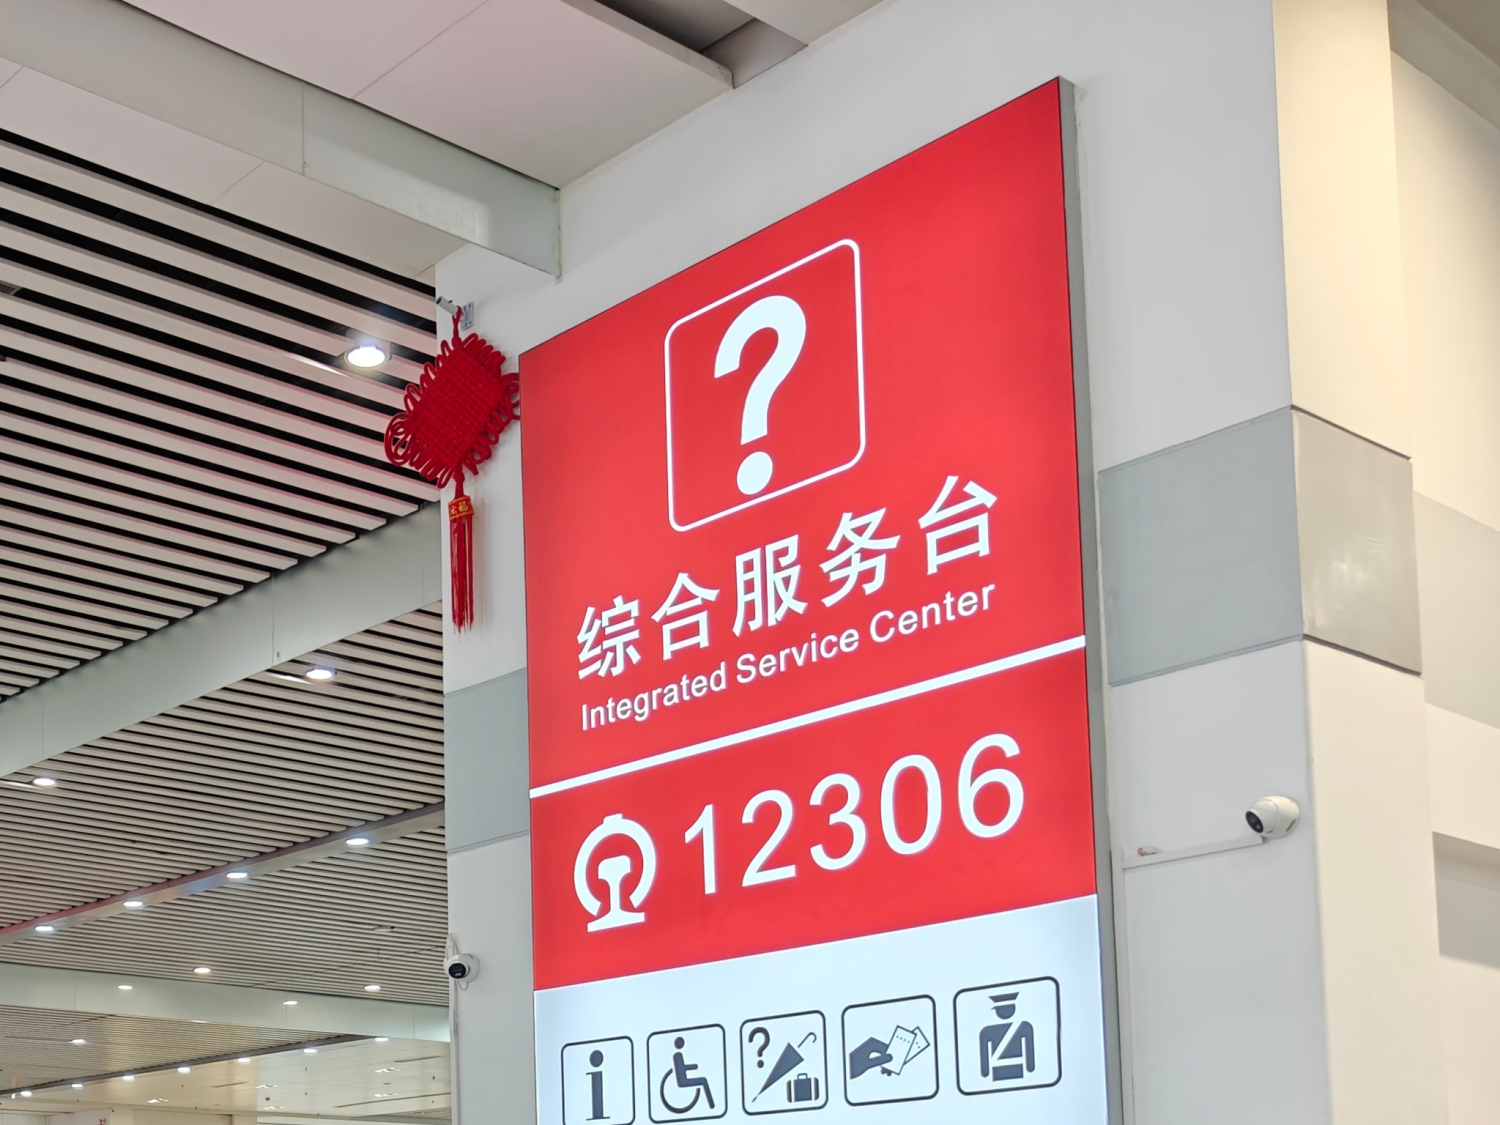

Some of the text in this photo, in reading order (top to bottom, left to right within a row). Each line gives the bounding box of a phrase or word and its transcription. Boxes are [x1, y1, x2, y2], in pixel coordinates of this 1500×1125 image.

[577, 475, 998, 681] 综合服务台
[581, 583, 996, 731] Integrated Service Center
[684, 733, 1025, 895] 12306
